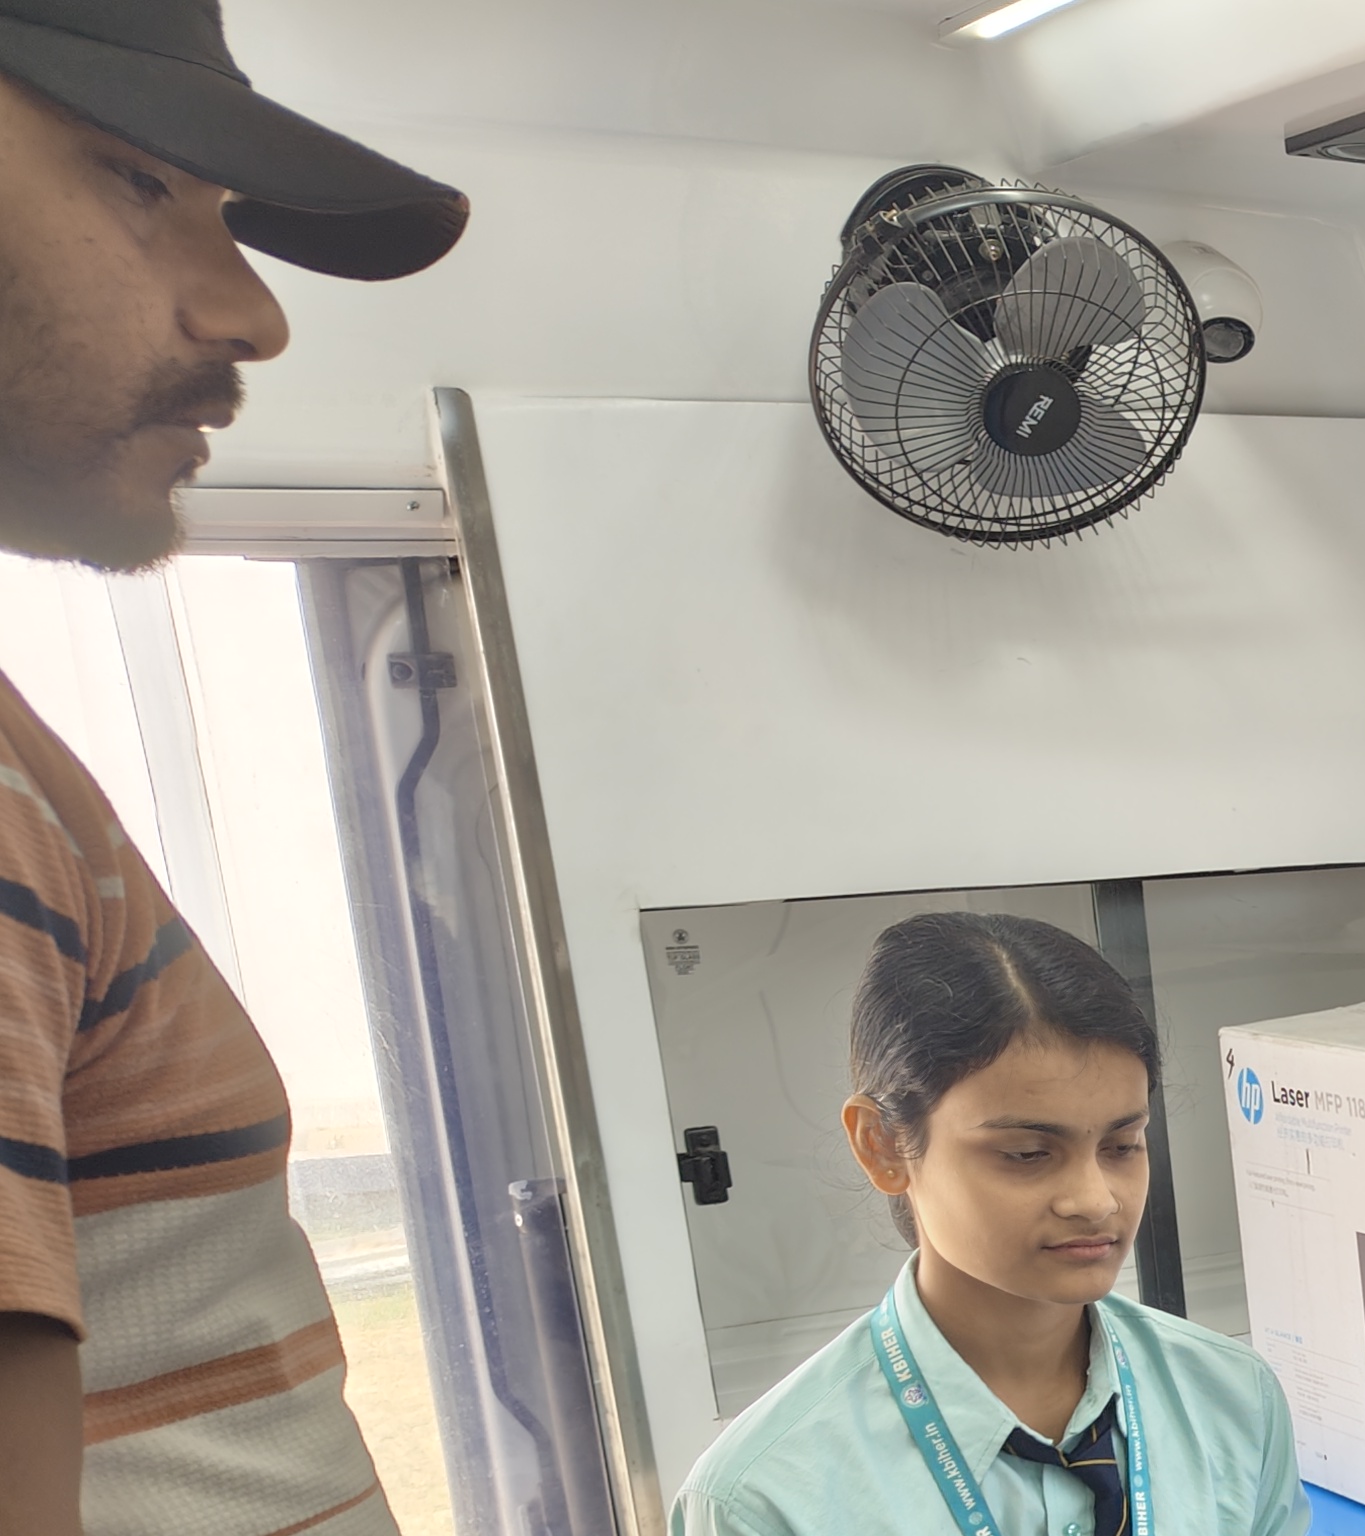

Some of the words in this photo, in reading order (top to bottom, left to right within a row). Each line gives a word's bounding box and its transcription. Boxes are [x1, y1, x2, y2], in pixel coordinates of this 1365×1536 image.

[1016, 395, 1054, 438] REMI
[1271, 1080, 1310, 1109] Laser
[1314, 1090, 1343, 1115] MFP
[881, 1326, 912, 1383] KBIHER
[925, 1421, 977, 1511] www.kbiher.in
